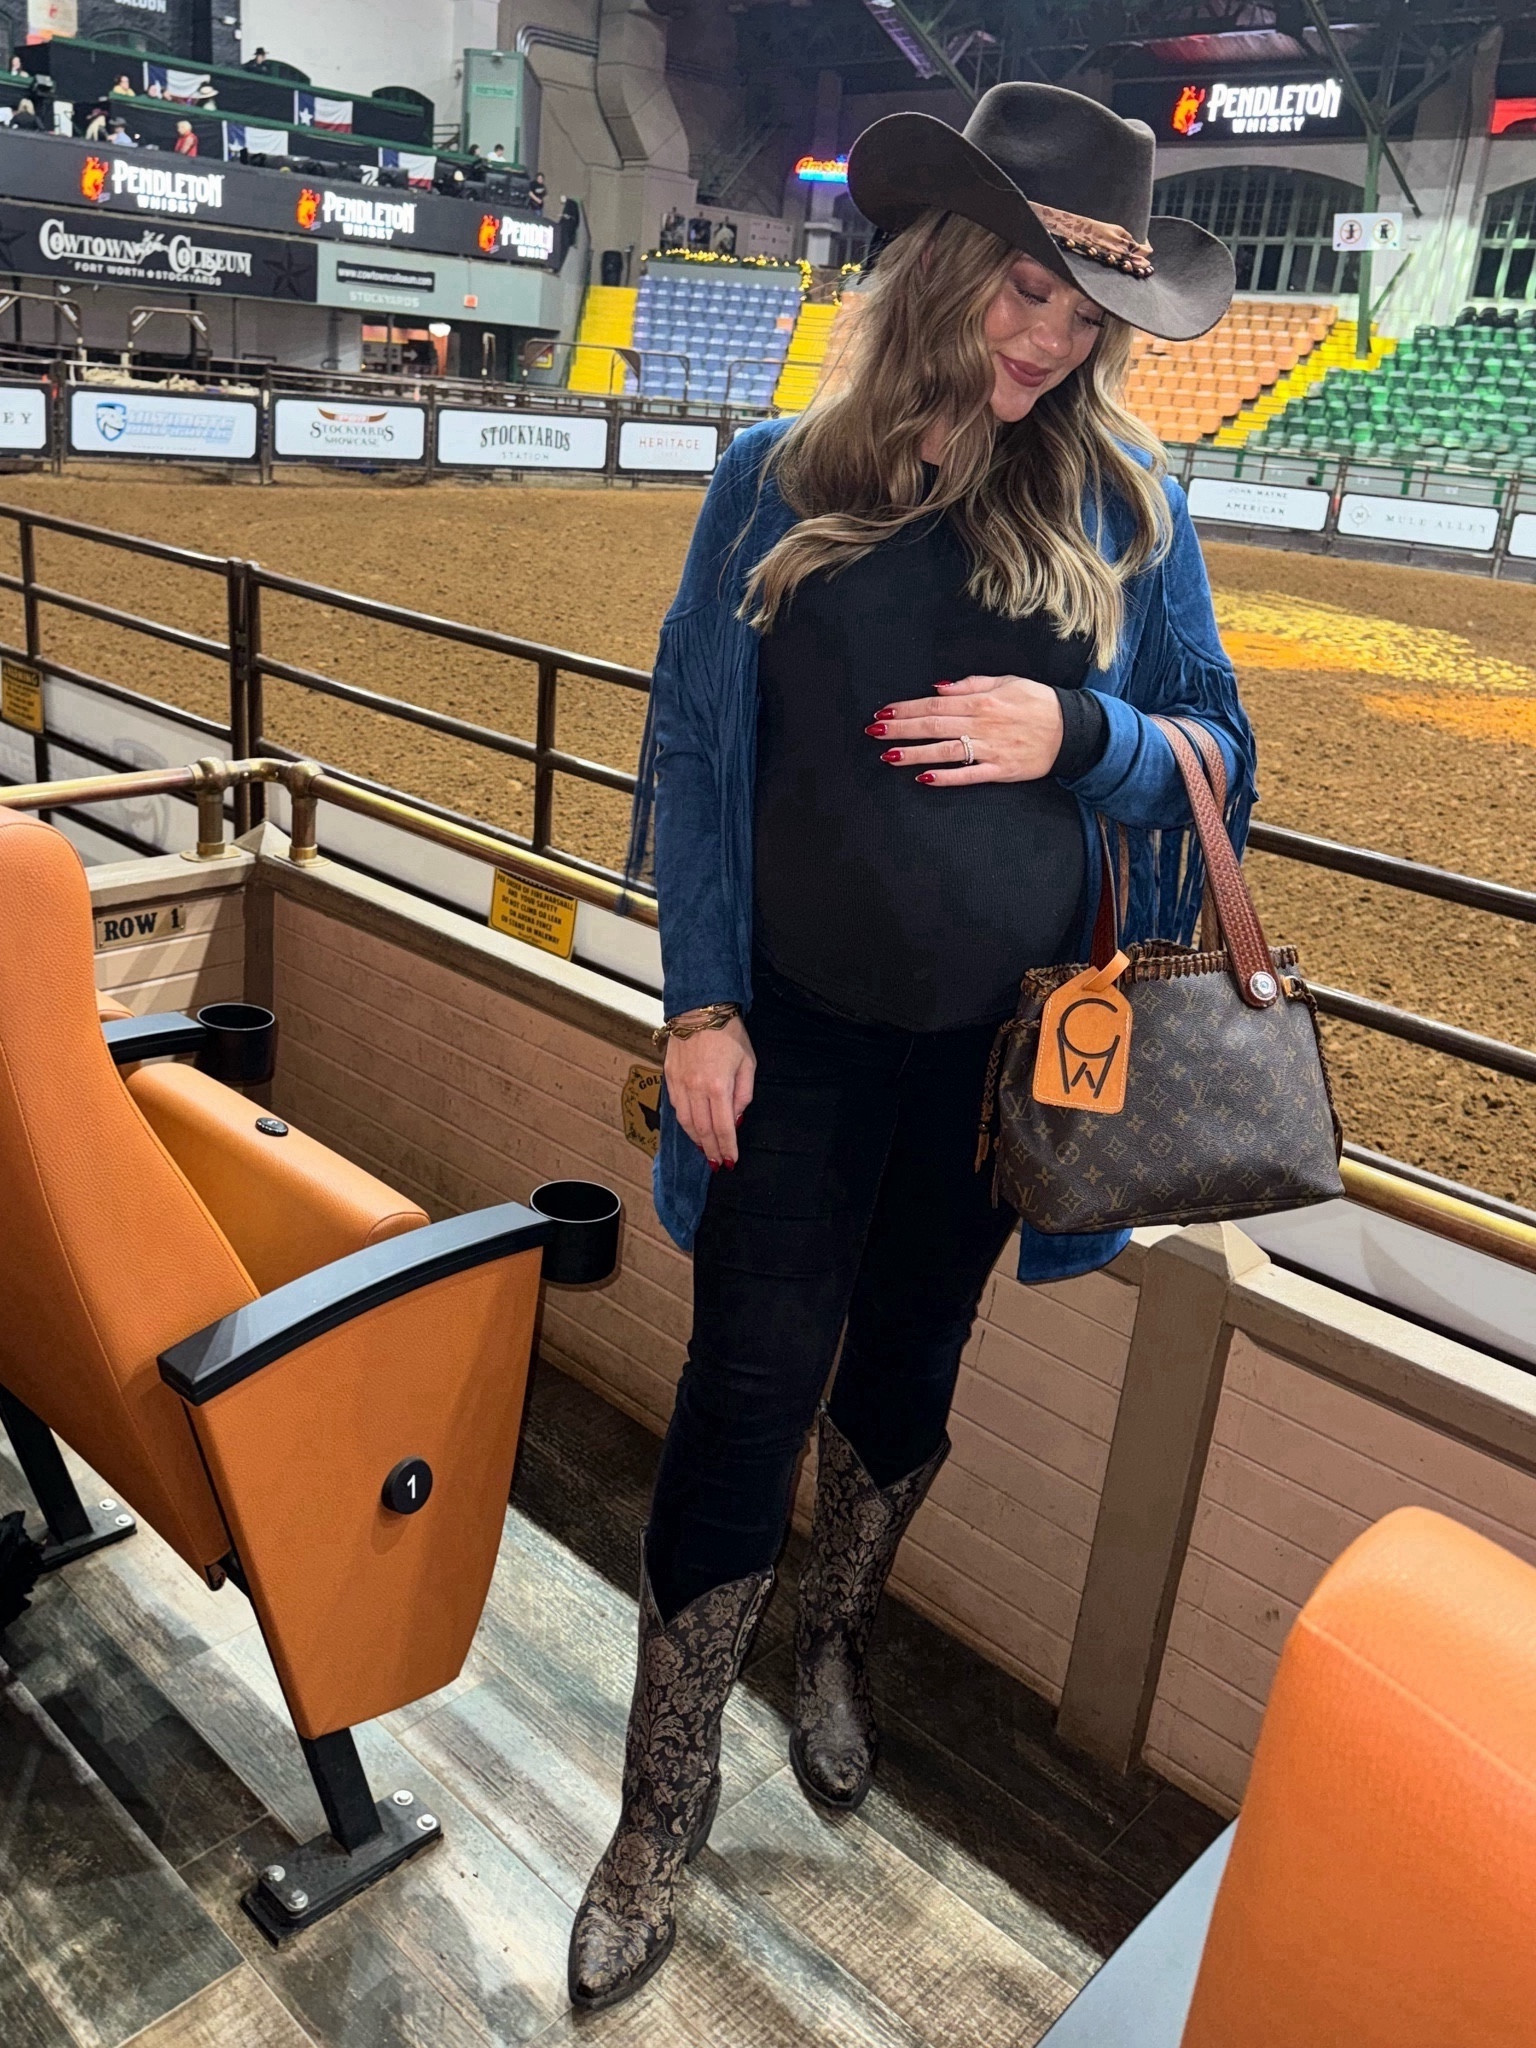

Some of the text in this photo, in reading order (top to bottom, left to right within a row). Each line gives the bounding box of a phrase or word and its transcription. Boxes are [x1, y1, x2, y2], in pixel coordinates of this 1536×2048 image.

[1207, 78, 1341, 122] PENDLETON
[1231, 116, 1306, 133] WHISKY
[111, 159, 222, 207] PENDLETON
[137, 195, 198, 214] WHISKY
[322, 191, 415, 234] PENDLETON
[342, 222, 394, 241] WHISKY
[39, 218, 252, 277] COWTOWN COLISEUM
[74, 261, 223, 286] FORT WORTH STOCKYARDS
[310, 421, 394, 441] STOCKYARDS
[480, 425, 571, 451] STOCKYARDS
[639, 437, 701, 450] HERITAGE
[1226, 502, 1285, 515] AMERICAN
[536, 899, 557, 913] SAFETY
[104, 908, 180, 942] ROW 1
[406, 1474, 416, 1499] 1
